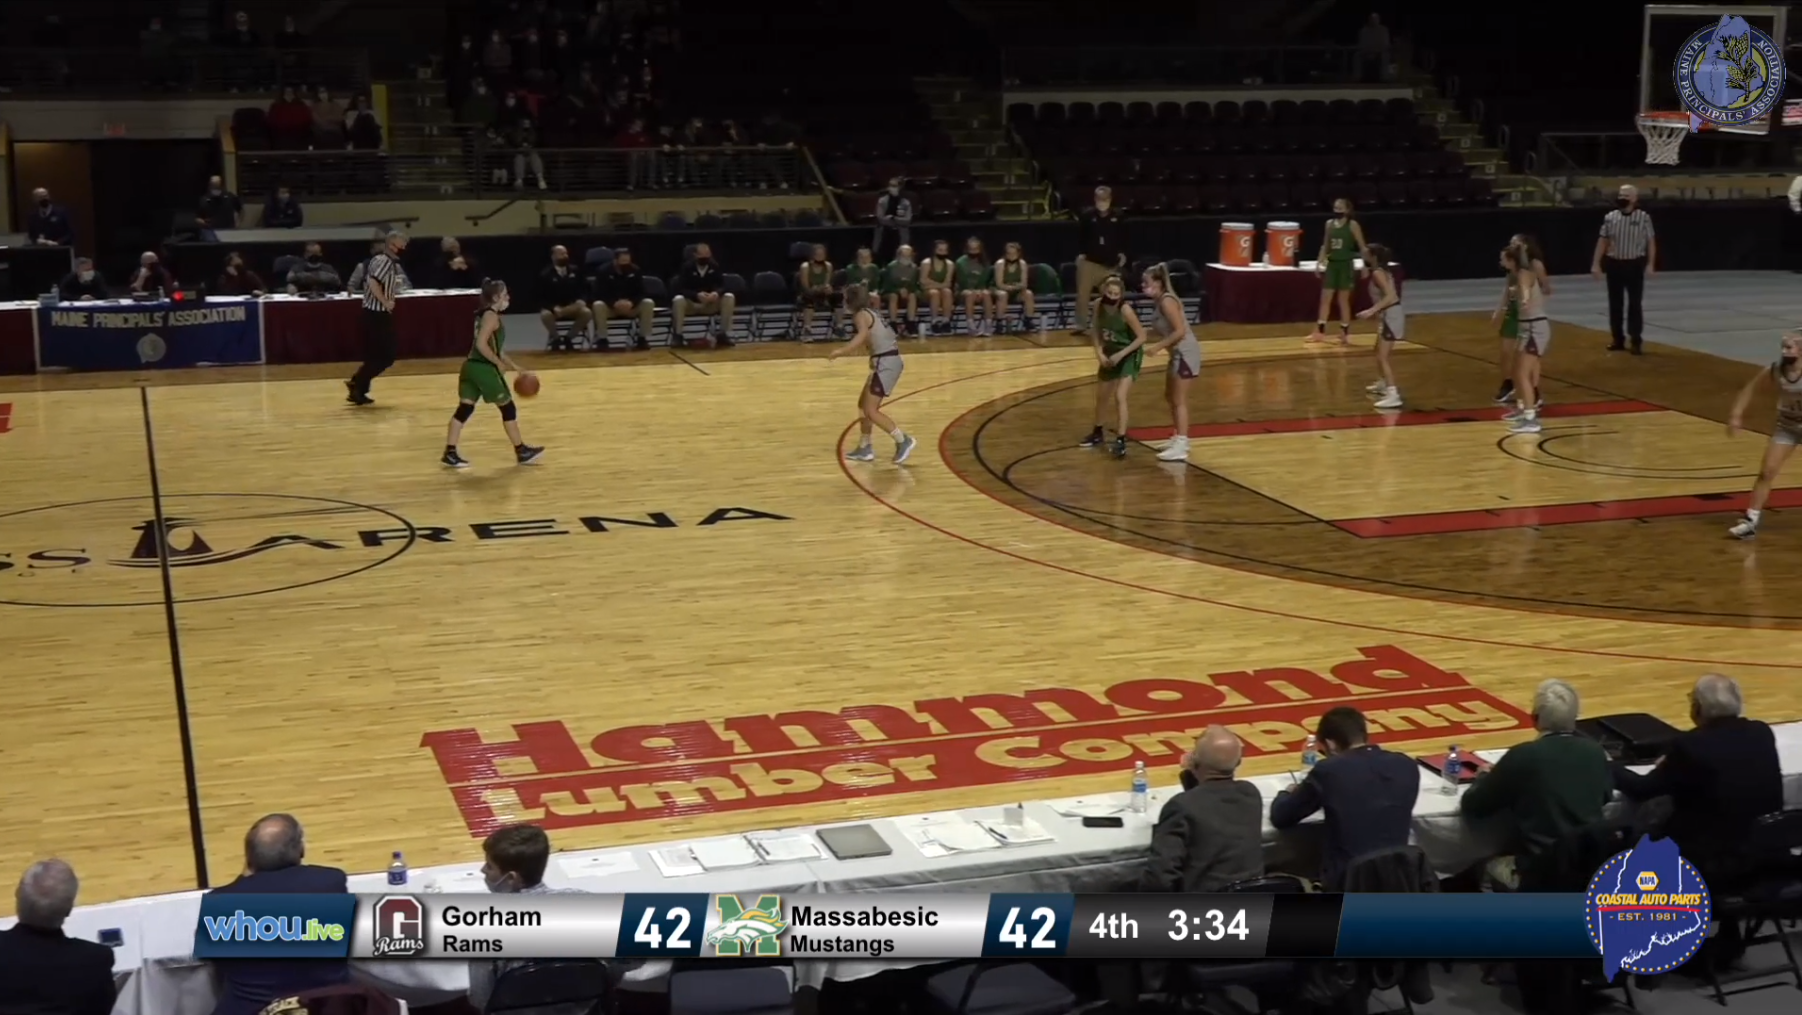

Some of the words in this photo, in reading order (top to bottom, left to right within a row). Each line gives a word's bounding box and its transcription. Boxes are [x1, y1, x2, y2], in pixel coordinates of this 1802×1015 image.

[1240, 236, 1250, 247] G
[1283, 236, 1294, 247] G
[51, 310, 88, 327] MAINE
[168, 306, 246, 326] ASSOCIATION
[419, 644, 1472, 785] Hammond
[480, 752, 937, 821] Lumber
